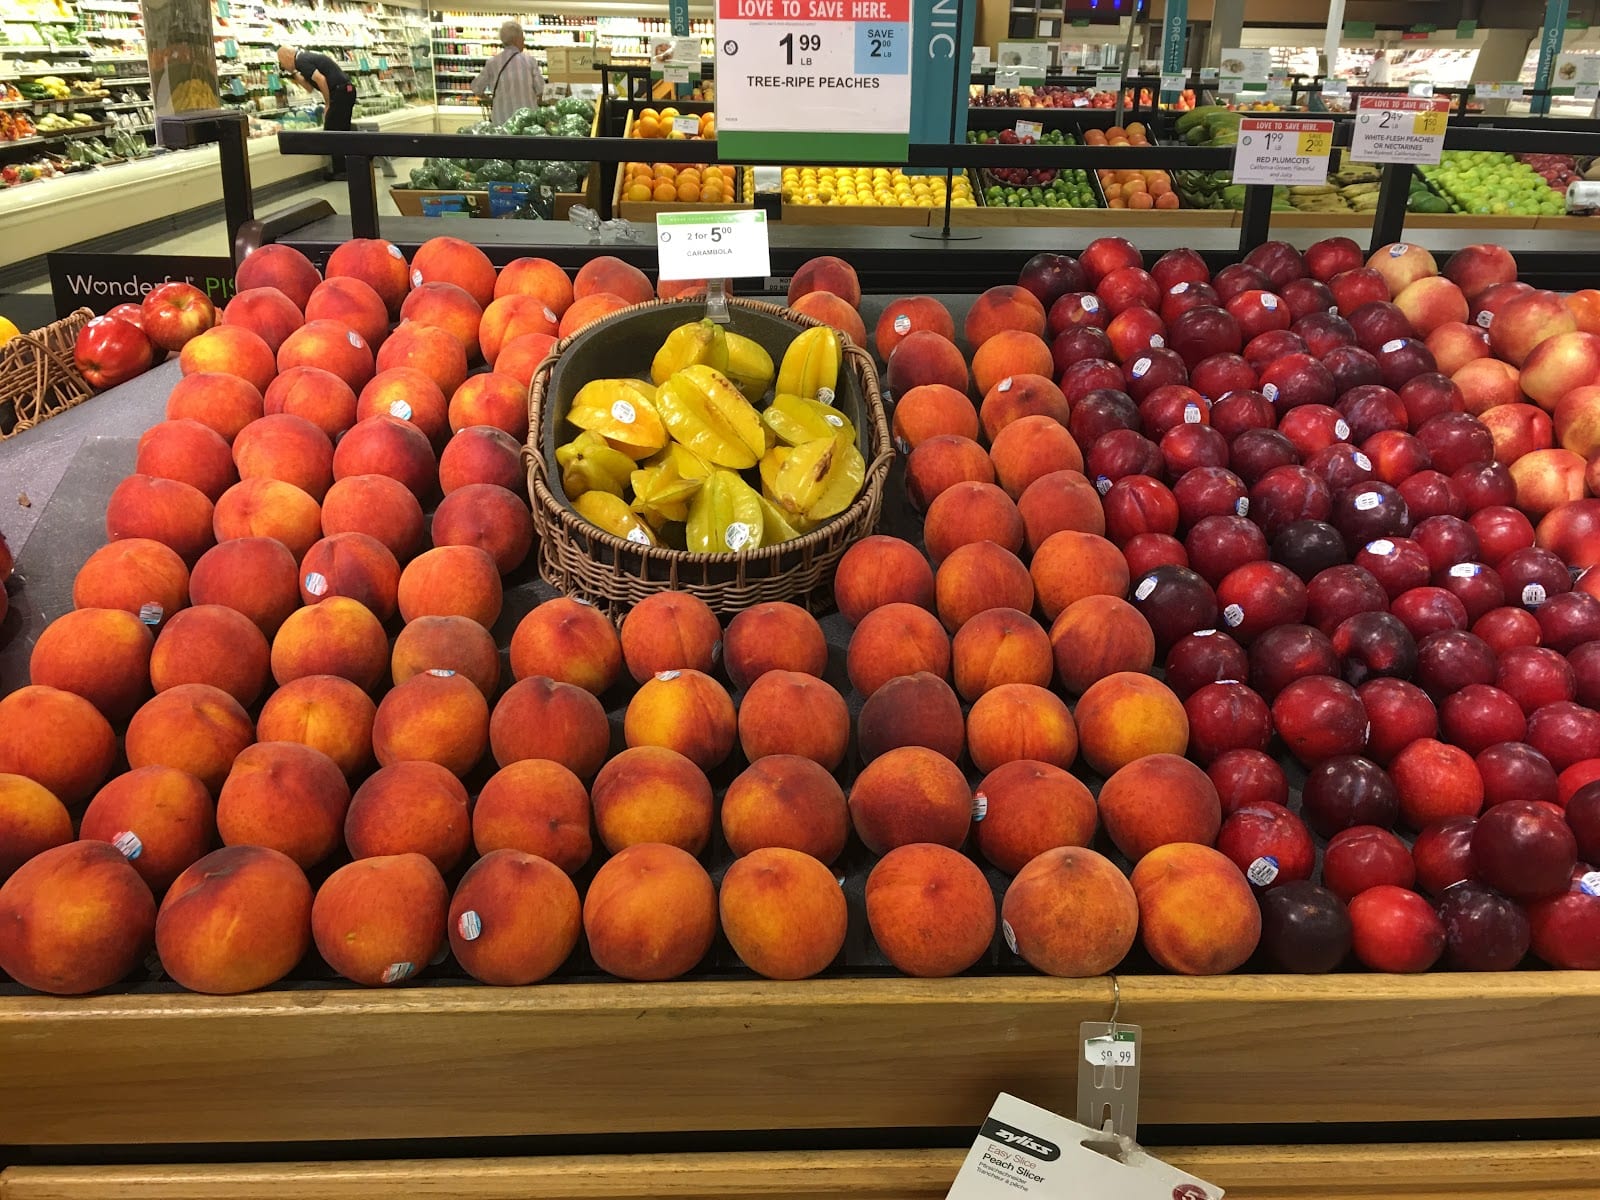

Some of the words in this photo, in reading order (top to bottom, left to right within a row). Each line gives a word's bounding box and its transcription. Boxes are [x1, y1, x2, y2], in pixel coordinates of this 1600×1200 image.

[738, 0, 773, 17] LOVE
[782, 0, 800, 17] TO
[809, 1, 844, 18] SAVE
[852, 1, 891, 19] HERE.
[867, 30, 894, 38] SAVE
[800, 58, 812, 66] LB
[747, 76, 815, 88] TREE-RIPE
[819, 77, 880, 88] PEACHES
[1374, 100, 1389, 108] LOVE
[1402, 101, 1417, 109] SAVE
[1256, 121, 1272, 130] LOVE
[1274, 122, 1283, 130] TO
[1285, 122, 1300, 130] SAVE
[1302, 123, 1319, 131] HERE.
[1364, 134, 1405, 142] WHITE-FLESH
[1407, 135, 1434, 143] PEACHES
[1384, 143, 1424, 151] NECTARINES
[687, 232, 693, 240] 2
[695, 232, 708, 240] for
[686, 248, 733, 257] CARAMBOLA
[66, 273, 190, 296] Wonde
[995, 1128, 1054, 1156] zyliss
[987, 1143, 1012, 1160] Easy
[1012, 1154, 1037, 1170] Slice
[982, 1152, 1015, 1171] Peach
[1016, 1166, 1046, 1183] Slicer
